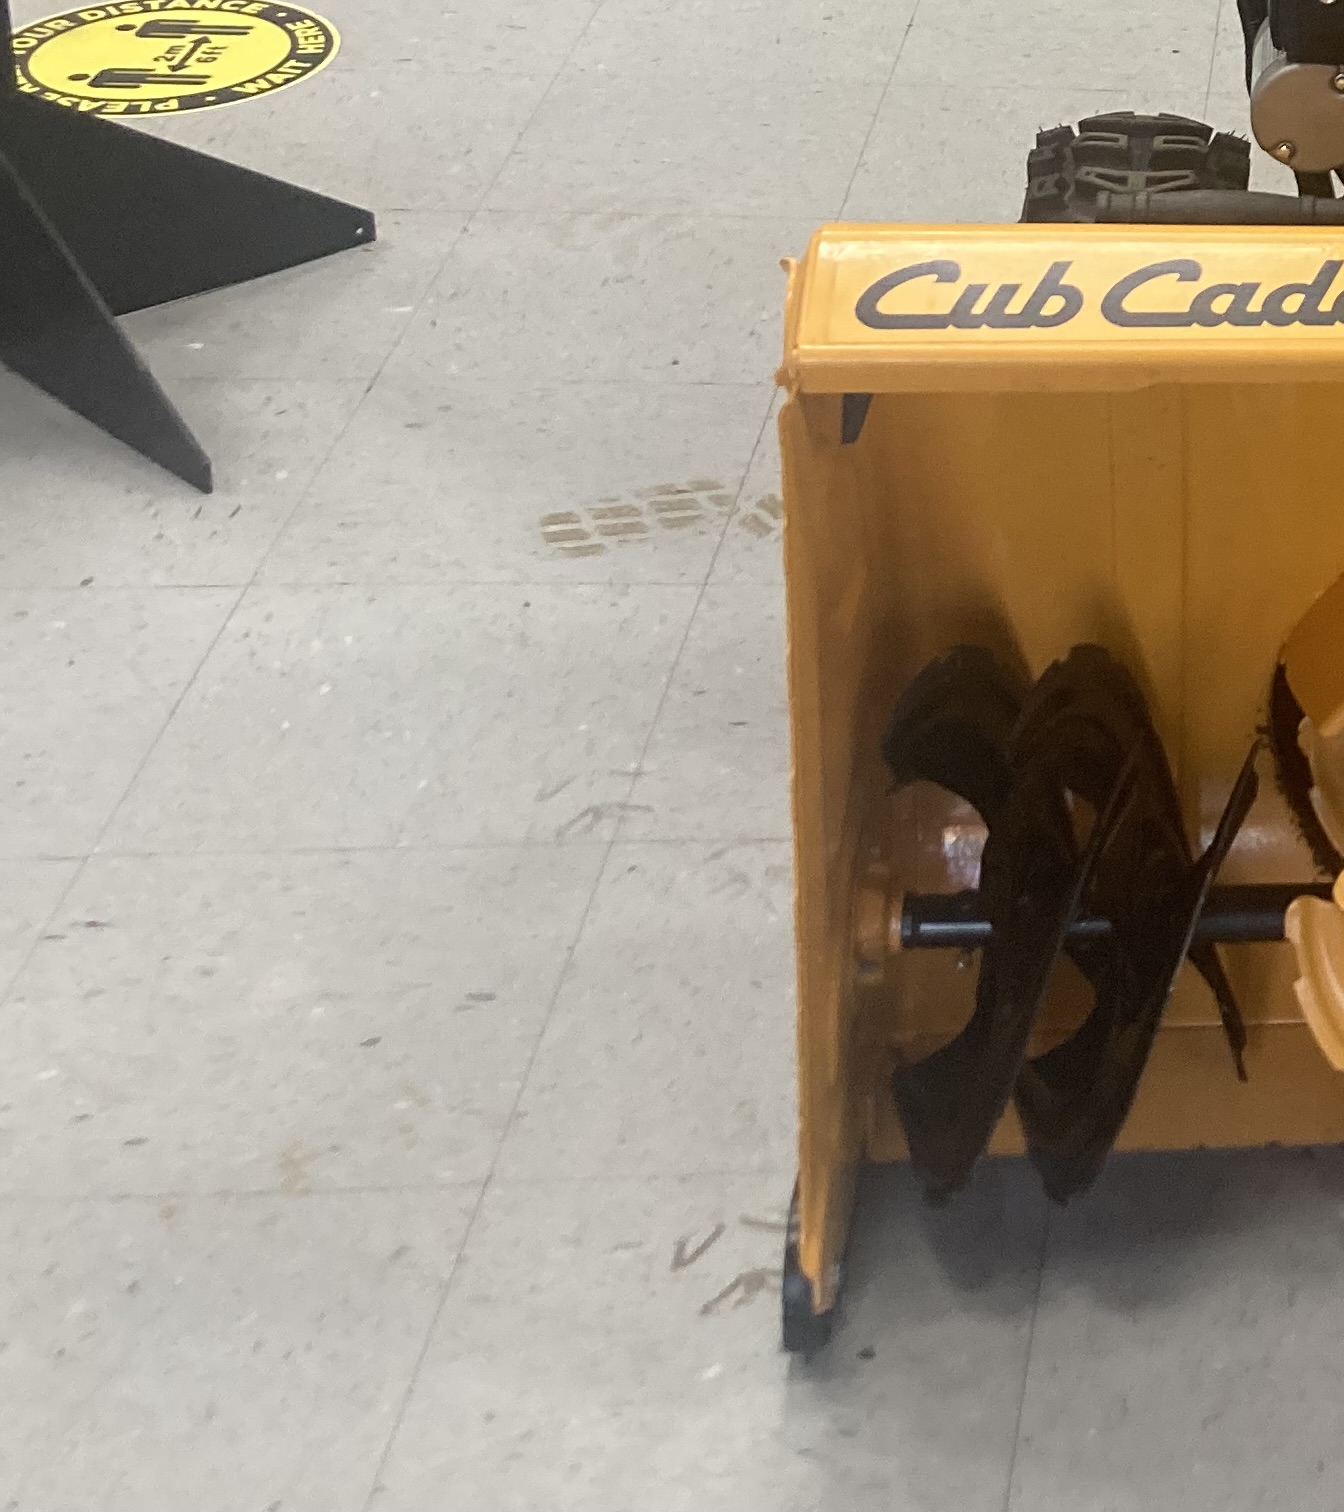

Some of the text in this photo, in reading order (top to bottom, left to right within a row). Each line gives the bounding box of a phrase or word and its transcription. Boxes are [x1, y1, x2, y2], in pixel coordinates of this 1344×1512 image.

[13, 19, 77, 55] OUR
[231, 19, 328, 94] WAIT HERE
[855, 259, 1084, 329] Cub
